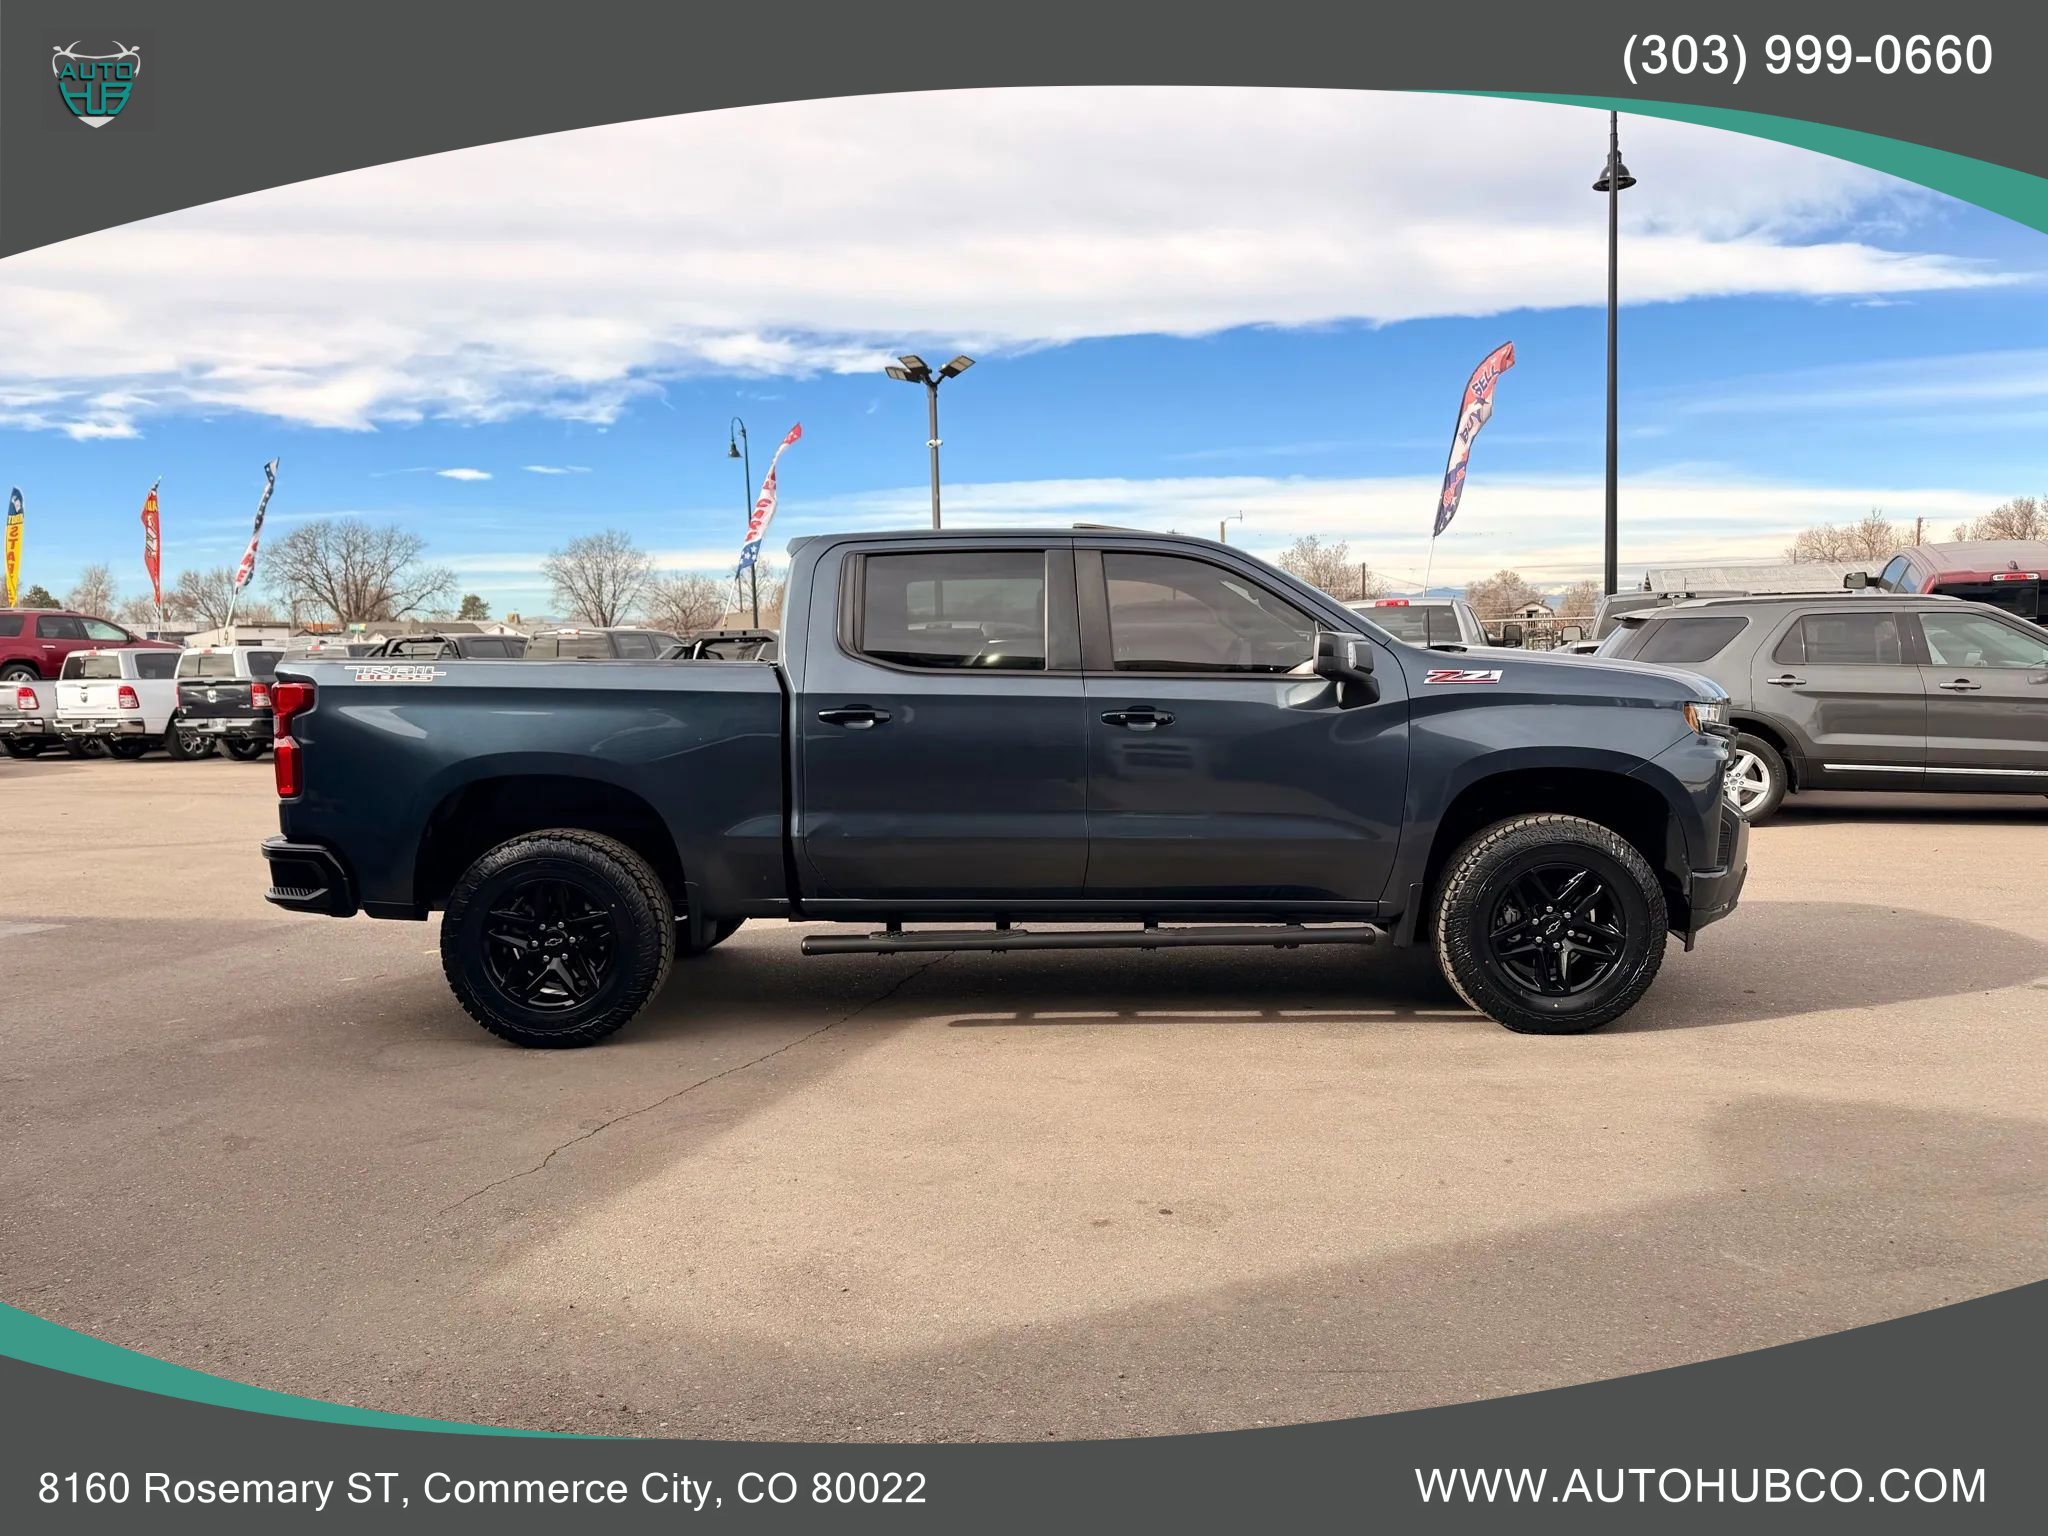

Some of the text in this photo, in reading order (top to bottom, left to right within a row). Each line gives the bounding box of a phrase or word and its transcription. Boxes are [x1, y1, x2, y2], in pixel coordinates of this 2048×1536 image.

[1460, 365, 1500, 444] BUY SELL
[344, 665, 447, 676] TRAIL
[1423, 669, 1504, 685] Z71
